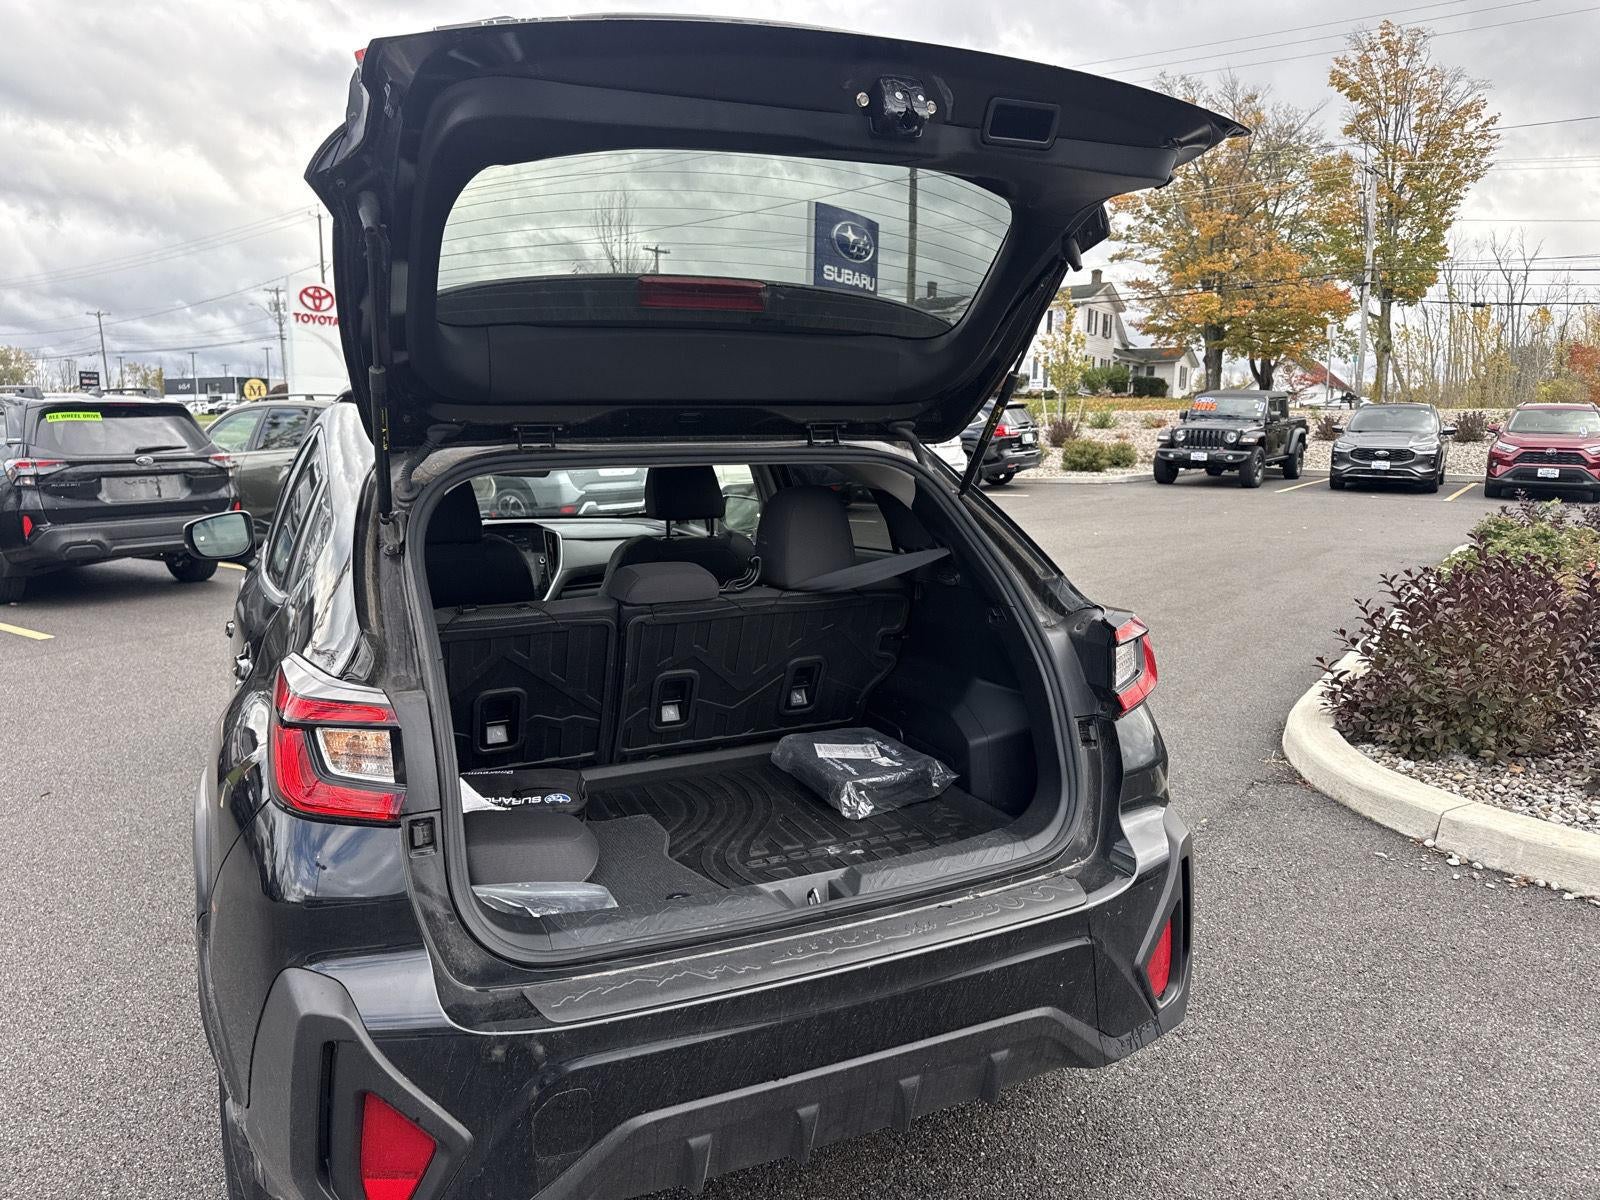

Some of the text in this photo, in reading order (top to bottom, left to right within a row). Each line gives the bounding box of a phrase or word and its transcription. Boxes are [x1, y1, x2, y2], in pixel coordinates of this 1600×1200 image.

[823, 265, 876, 291] SUBARU
[293, 312, 339, 327] TOYOTA
[249, 385, 262, 397] M
